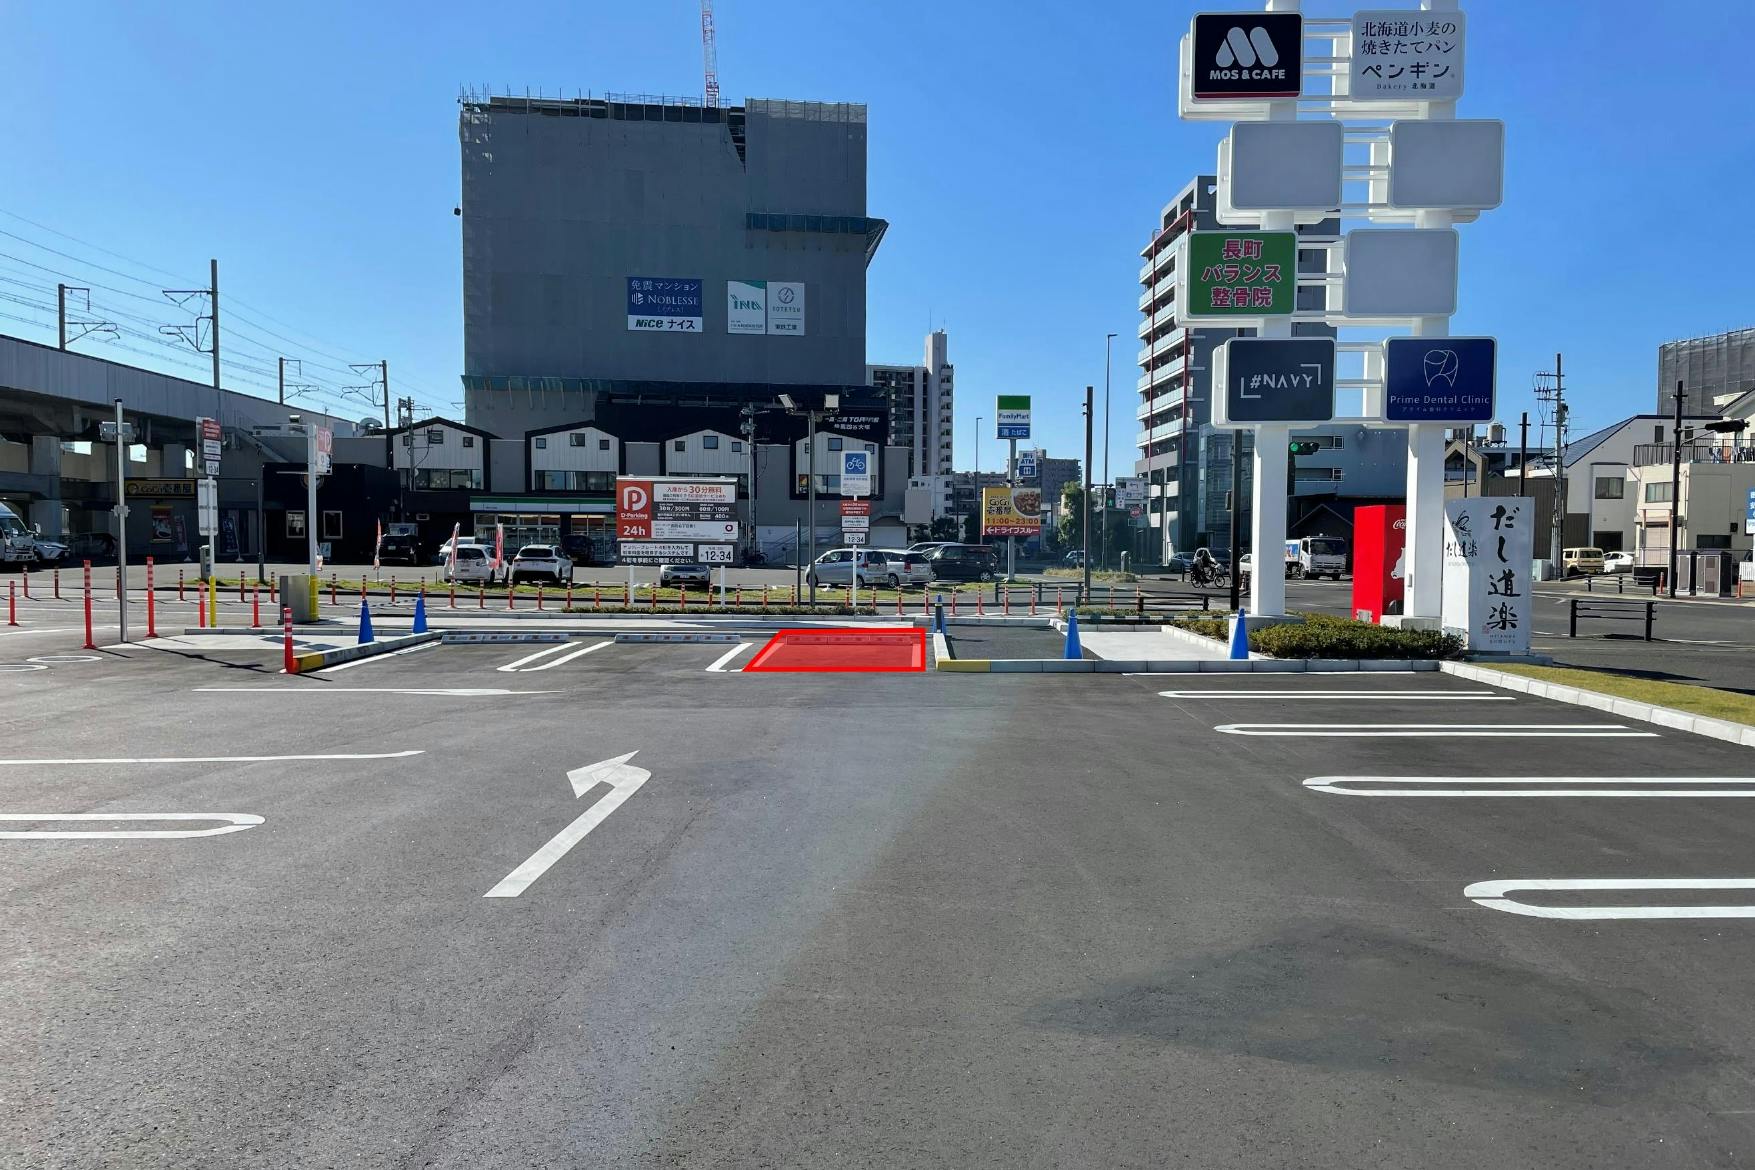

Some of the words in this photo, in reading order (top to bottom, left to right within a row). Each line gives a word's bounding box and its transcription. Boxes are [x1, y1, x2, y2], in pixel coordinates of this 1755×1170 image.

[1361, 21, 1456, 37] 北海道小麦の
[1361, 39, 1456, 55] 焼きたてパン
[1209, 69, 1239, 80] MOS
[1241, 69, 1250, 80] &
[1252, 69, 1285, 80] CAFE
[1361, 62, 1450, 79] ペンギン
[1222, 239, 1264, 260] 長町
[1201, 264, 1282, 283] バランス
[1211, 287, 1273, 308] 整骨院
[667, 318, 695, 329] ナイス
[1390, 395, 1420, 404] Prime
[1423, 395, 1457, 404] Dental
[1461, 395, 1489, 404] Clinic
[998, 412, 1030, 420] FamilyMart
[623, 526, 646, 536] 24h
[994, 526, 1039, 534] ドライブスルー
[1486, 504, 1521, 631] だし道楽
